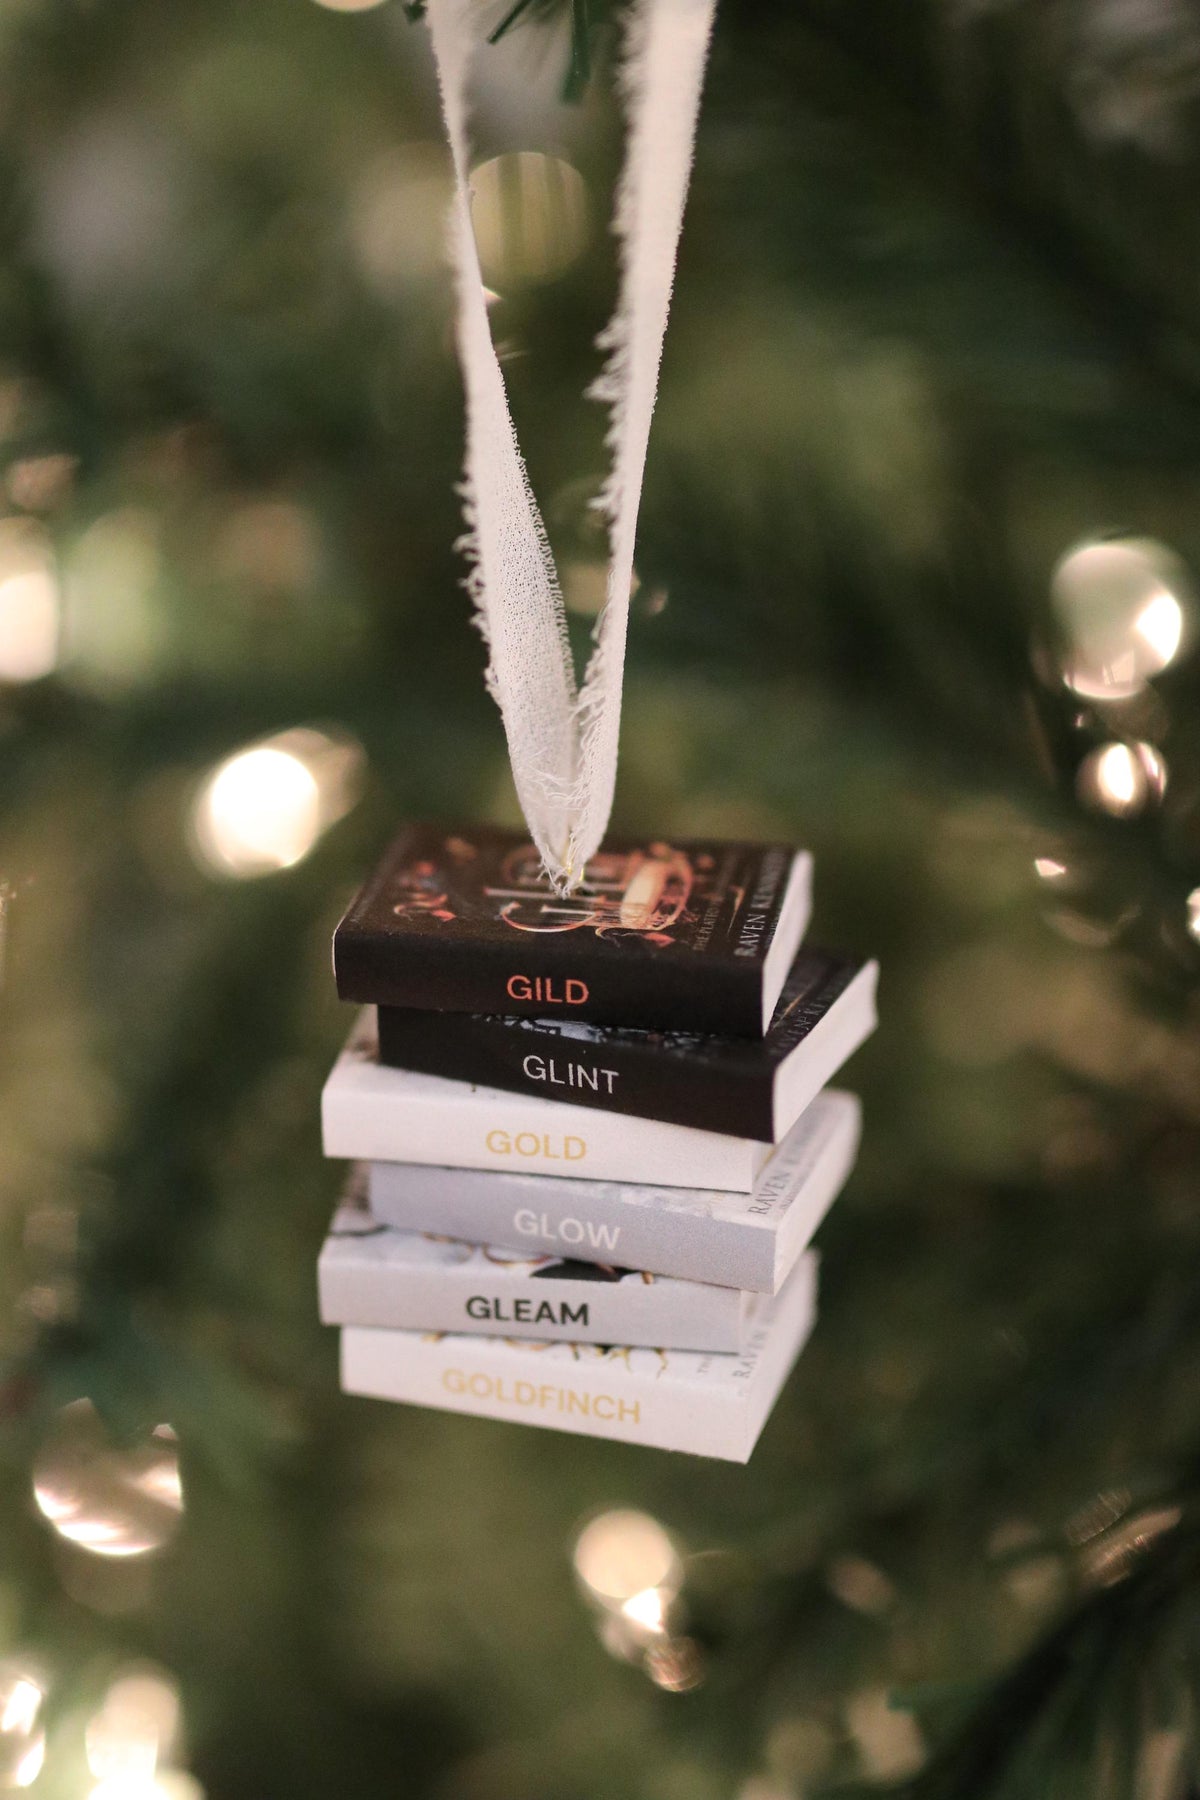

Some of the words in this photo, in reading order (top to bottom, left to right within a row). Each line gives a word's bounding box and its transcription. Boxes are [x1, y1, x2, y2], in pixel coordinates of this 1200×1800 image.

[733, 913, 767, 957] RAVEN
[506, 974, 590, 1004] GILD
[523, 1055, 619, 1094] GLINT
[485, 1129, 588, 1161] GOLD
[747, 1171, 791, 1214] RAVEN
[513, 1208, 621, 1251] GLOW
[466, 1295, 589, 1326] GLEAM
[442, 1368, 641, 1424] GOLDFINCH
